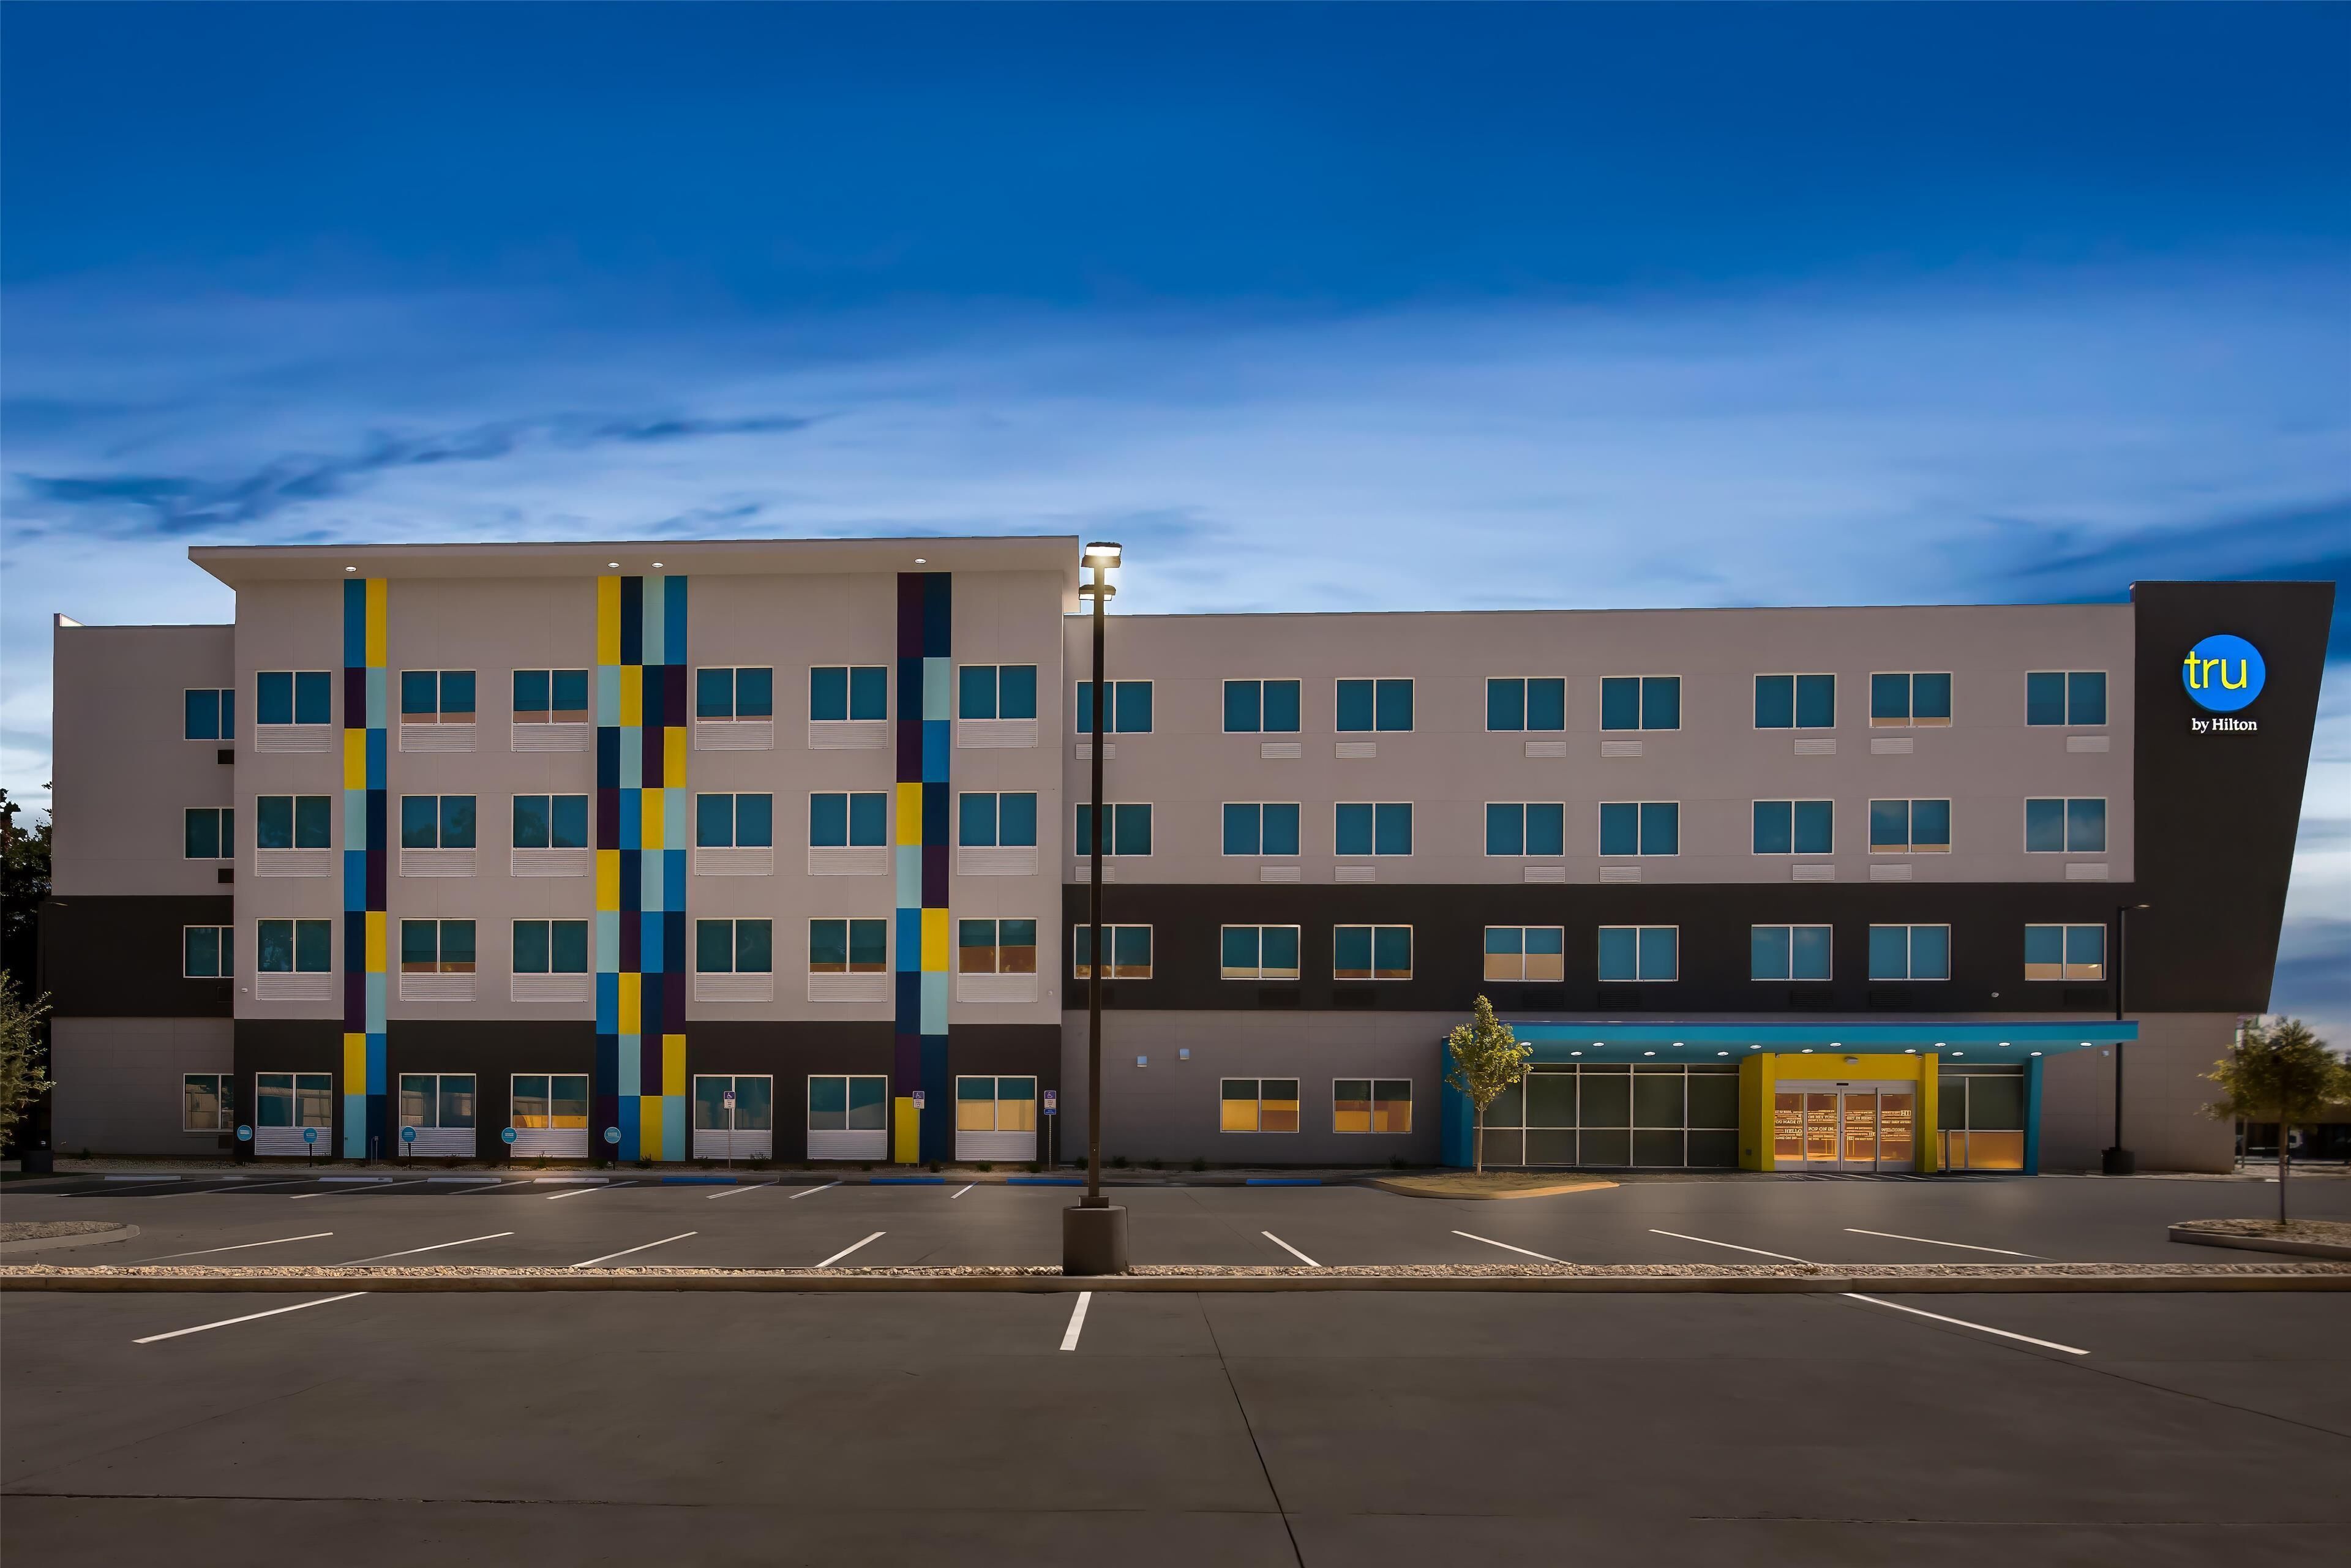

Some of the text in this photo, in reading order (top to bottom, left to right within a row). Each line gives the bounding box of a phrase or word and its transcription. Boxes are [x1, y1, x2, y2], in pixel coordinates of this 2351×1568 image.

[2184, 651, 2247, 689] tru
[2192, 718, 2257, 733] by Hilton
